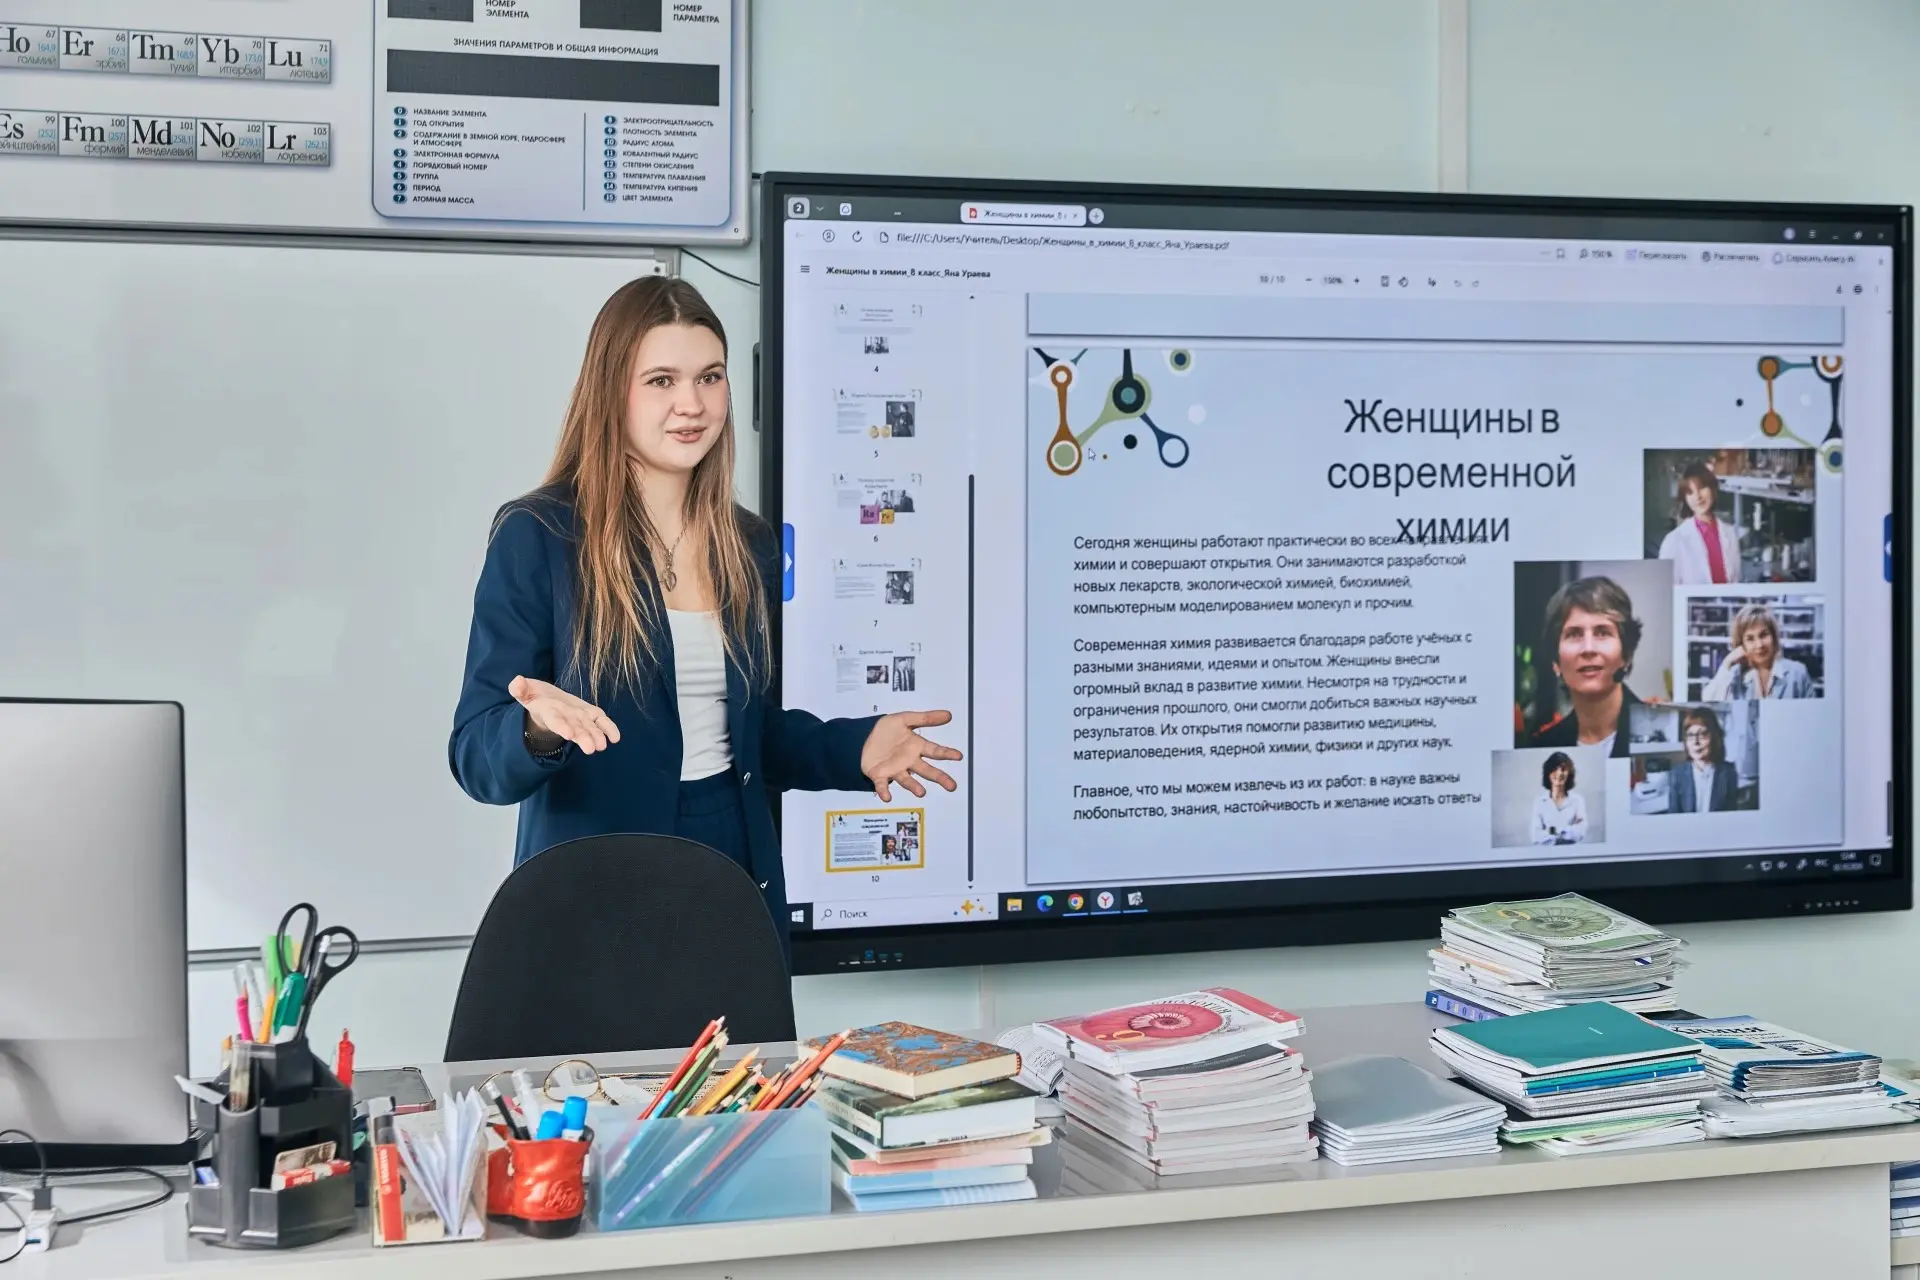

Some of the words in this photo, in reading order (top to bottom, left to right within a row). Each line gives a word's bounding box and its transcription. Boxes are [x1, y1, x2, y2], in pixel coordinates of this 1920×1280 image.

[485, 9, 530, 19] ЭЛЕМЕНТА
[673, 4, 703, 13] НОМЕР
[673, 14, 720, 24] ПАРАМЕТРА
[46, 30, 56, 39] 67
[116, 33, 126, 42] 68
[62, 30, 94, 57] Er
[132, 34, 175, 61] Tm
[252, 41, 262, 49] 70
[319, 44, 328, 52] 71
[453, 38, 497, 48] ЗНАЧЕНИЯ
[499, 40, 554, 51] ПАРАМЕТРОВ
[565, 44, 596, 54] ОБЩАЯ
[598, 45, 659, 57] ИНФОРМАЦИЯ
[201, 37, 240, 65] Yb
[268, 41, 303, 67] Lu
[289, 68, 328, 79] лютеций
[413, 108, 449, 116] НАЗВАНИЕ
[45, 116, 56, 125] 99
[110, 119, 126, 128] 100
[413, 120, 427, 128] ГОД
[429, 120, 464, 128] ОТКРЫТИЯ
[62, 116, 105, 142] Fm
[132, 119, 172, 145] Md
[180, 122, 194, 131] 101
[247, 125, 261, 133] 102
[313, 128, 327, 136] 103
[623, 128, 662, 136] ПЛОТНОСТЬ
[200, 122, 236, 149] No
[267, 125, 297, 150] Lr
[413, 131, 461, 140] СОДЕРЖАНИЕ
[469, 133, 499, 141] ЗЕМНОЙ
[521, 136, 566, 144] ГИДРОСФЕРЕ
[420, 140, 462, 148] АТМОСФЕРЕ
[623, 139, 649, 147] РАДИУС
[651, 140, 674, 148] АТОМА
[137, 147, 194, 157] менделевий
[222, 149, 262, 160] нобелий
[413, 151, 463, 159] ЭЛЕКТРОННАЯ
[464, 152, 500, 160] ФОРМУЛА
[623, 150, 670, 159] КОВАЛЕНТНЫЙ
[672, 152, 699, 160] РАДИУС
[413, 162, 461, 170] ПОРЯДКОВЫЙ
[463, 163, 488, 171] НОМЕР
[623, 161, 651, 169] СТЕПЕНИ
[413, 173, 439, 181] ГРУППА
[623, 173, 666, 181] ТЕМПЕРАТУРА
[413, 184, 441, 192] ПЕРИОД
[622, 195, 638, 203] ЦВЕТ
[640, 195, 673, 203] ЭЛЕМЕНТА
[826, 266, 870, 277] Женщины
[962, 271, 991, 279] Ураева
[1344, 399, 1533, 440] Женщины
[1542, 408, 1560, 433] в
[1327, 454, 1576, 497] современной
[1396, 517, 1510, 543] химии
[1074, 536, 1130, 551] Сегодня
[1133, 536, 1198, 550] женщины
[1201, 534, 1264, 550] работают
[1267, 536, 1347, 549] практически
[1350, 536, 1364, 546] во
[1369, 535, 1396, 546] всех
[1074, 559, 1116, 571] химии
[1119, 560, 1127, 570] и
[1131, 558, 1206, 573] совершают
[1210, 557, 1273, 572] открытия.
[1276, 556, 1303, 568] Они
[1306, 556, 1384, 568] занимаются
[1387, 553, 1467, 569] разработкой
[1074, 582, 1116, 593] новых
[1119, 580, 1183, 594] лекарств,
[1187, 577, 1283, 591] экологической
[1286, 577, 1336, 590] химией,
[1340, 575, 1413, 589] биохимией,
[1074, 602, 1176, 616] компьютерным
[1180, 600, 1294, 614] моделированием
[1297, 599, 1351, 612] молекул
[1365, 598, 1414, 610] прочим.
[1074, 638, 1167, 654] Современная
[1170, 639, 1211, 649] химия
[1214, 636, 1296, 651] развивается
[1300, 633, 1366, 648] благодаря
[1369, 632, 1413, 647] работе
[1416, 632, 1462, 647] учёных
[1074, 661, 1133, 676] разными
[1137, 659, 1204, 673] знаниями,
[1208, 658, 1257, 671] идеями
[1273, 657, 1323, 668] опытом.
[1326, 655, 1392, 667] Женщины
[1395, 654, 1440, 665] внесли
[1074, 682, 1140, 697] огромный
[1144, 682, 1183, 693] вклад
[1197, 679, 1258, 694] развитие
[1261, 678, 1304, 689] химии.
[1307, 676, 1370, 690] Несмотря
[1373, 676, 1389, 686] на
[1392, 674, 1456, 688] трудности
[1074, 703, 1159, 719] ограничения
[1163, 702, 1230, 717] прошлого,
[1234, 701, 1258, 712] они
[1261, 700, 1307, 711] смогли
[1309, 696, 1369, 711] добиться
[1373, 696, 1421, 708] важных
[1424, 695, 1477, 708] научных
[1074, 725, 1158, 741] результатов.
[1160, 724, 1178, 736] Их
[1182, 722, 1242, 738] открытия
[1246, 721, 1300, 733] помогли
[1304, 718, 1365, 734] развитию
[1368, 716, 1437, 729] медицины,
[1074, 745, 1206, 762] материаловедения,
[1210, 742, 1265, 757] ядерной
[1268, 741, 1311, 754] химии,
[1315, 738, 1363, 754] физики
[1377, 737, 1418, 751] других
[1074, 784, 1133, 799] Главное,
[1136, 784, 1159, 795] что
[1162, 783, 1182, 794] мы
[1186, 781, 1231, 793] можем
[1235, 780, 1286, 791] извлечь
[1290, 779, 1304, 789] из
[1307, 778, 1322, 788] их
[1326, 775, 1366, 790] работ:
[1381, 774, 1416, 788] науке
[1419, 773, 1460, 784] важны
[1073, 806, 1167, 821] любопытство,
[1171, 803, 1220, 817] знания,
[1224, 799, 1320, 813] настойчивость
[1334, 796, 1389, 808] желание
[1393, 795, 1434, 806] искать
[1438, 793, 1482, 804] ответы
[839, 909, 868, 919] Поиск
